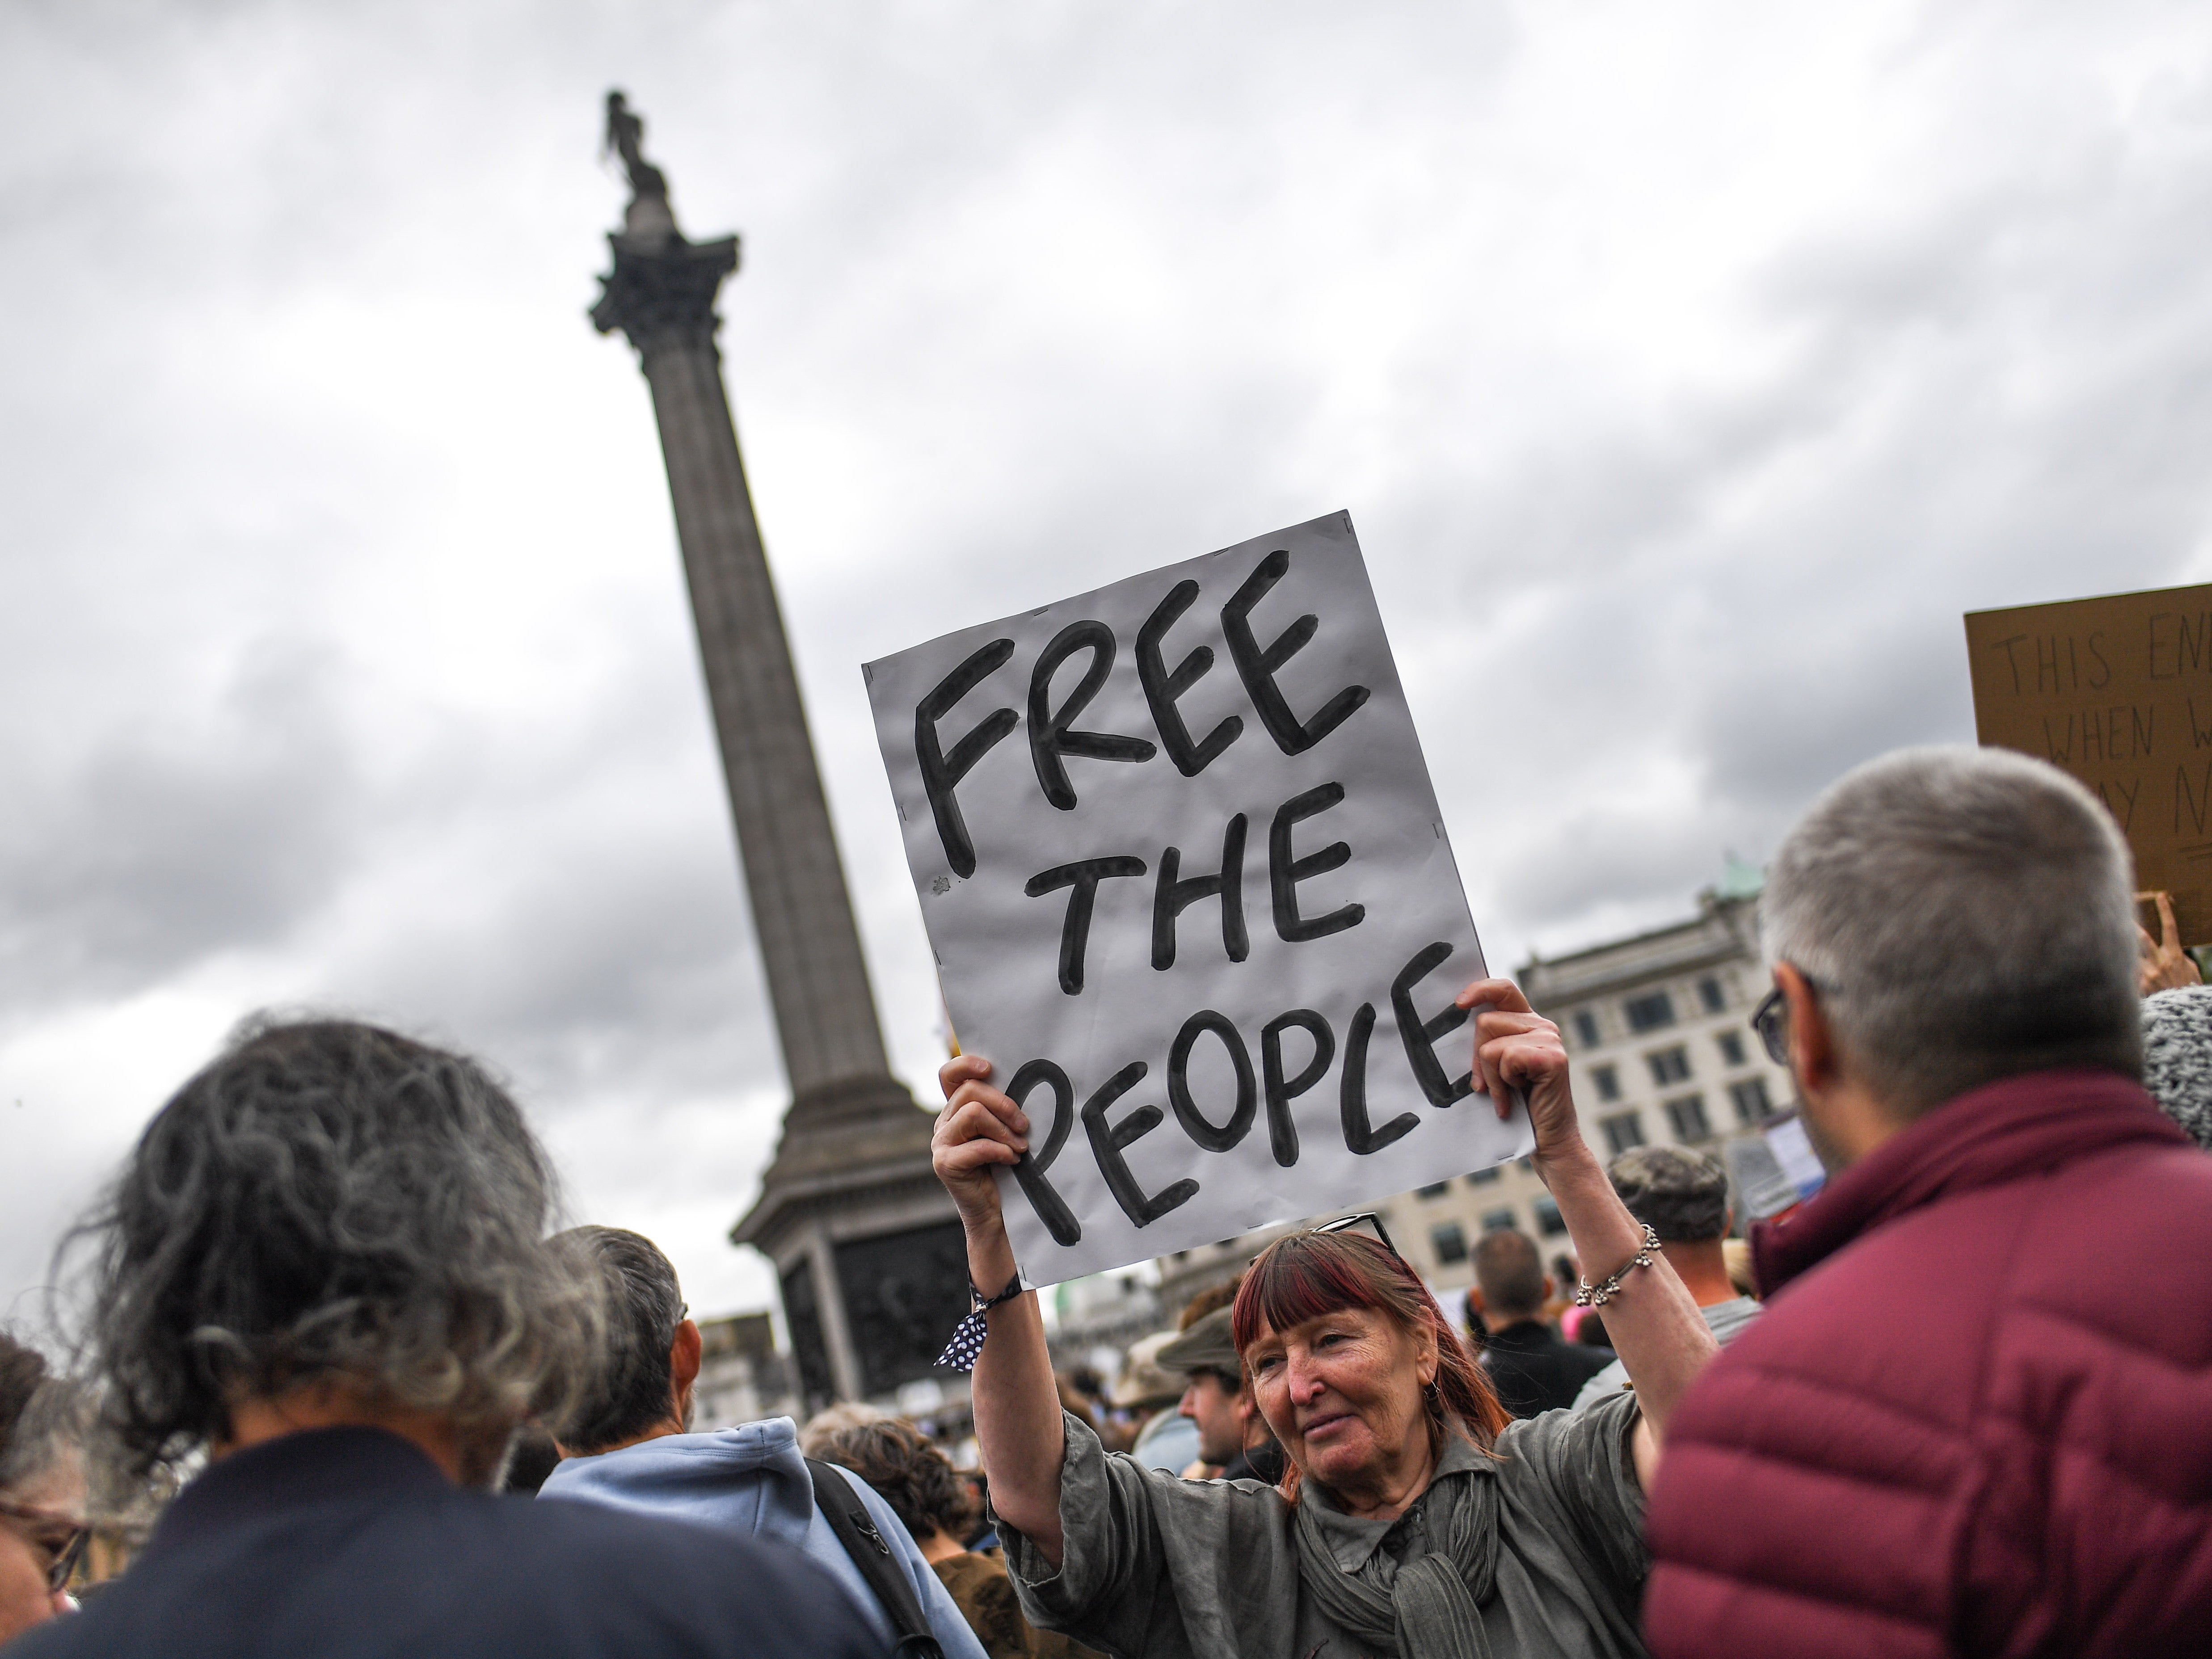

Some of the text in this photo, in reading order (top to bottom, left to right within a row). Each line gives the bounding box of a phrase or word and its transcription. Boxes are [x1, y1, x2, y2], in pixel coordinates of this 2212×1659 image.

[915, 549, 1370, 879] FREE
[1992, 611, 2212, 695] THIS EN
[2044, 704, 2154, 762] WHEN
[1024, 781, 1365, 996] THE
[1003, 941, 1476, 1247] PEOPLE
